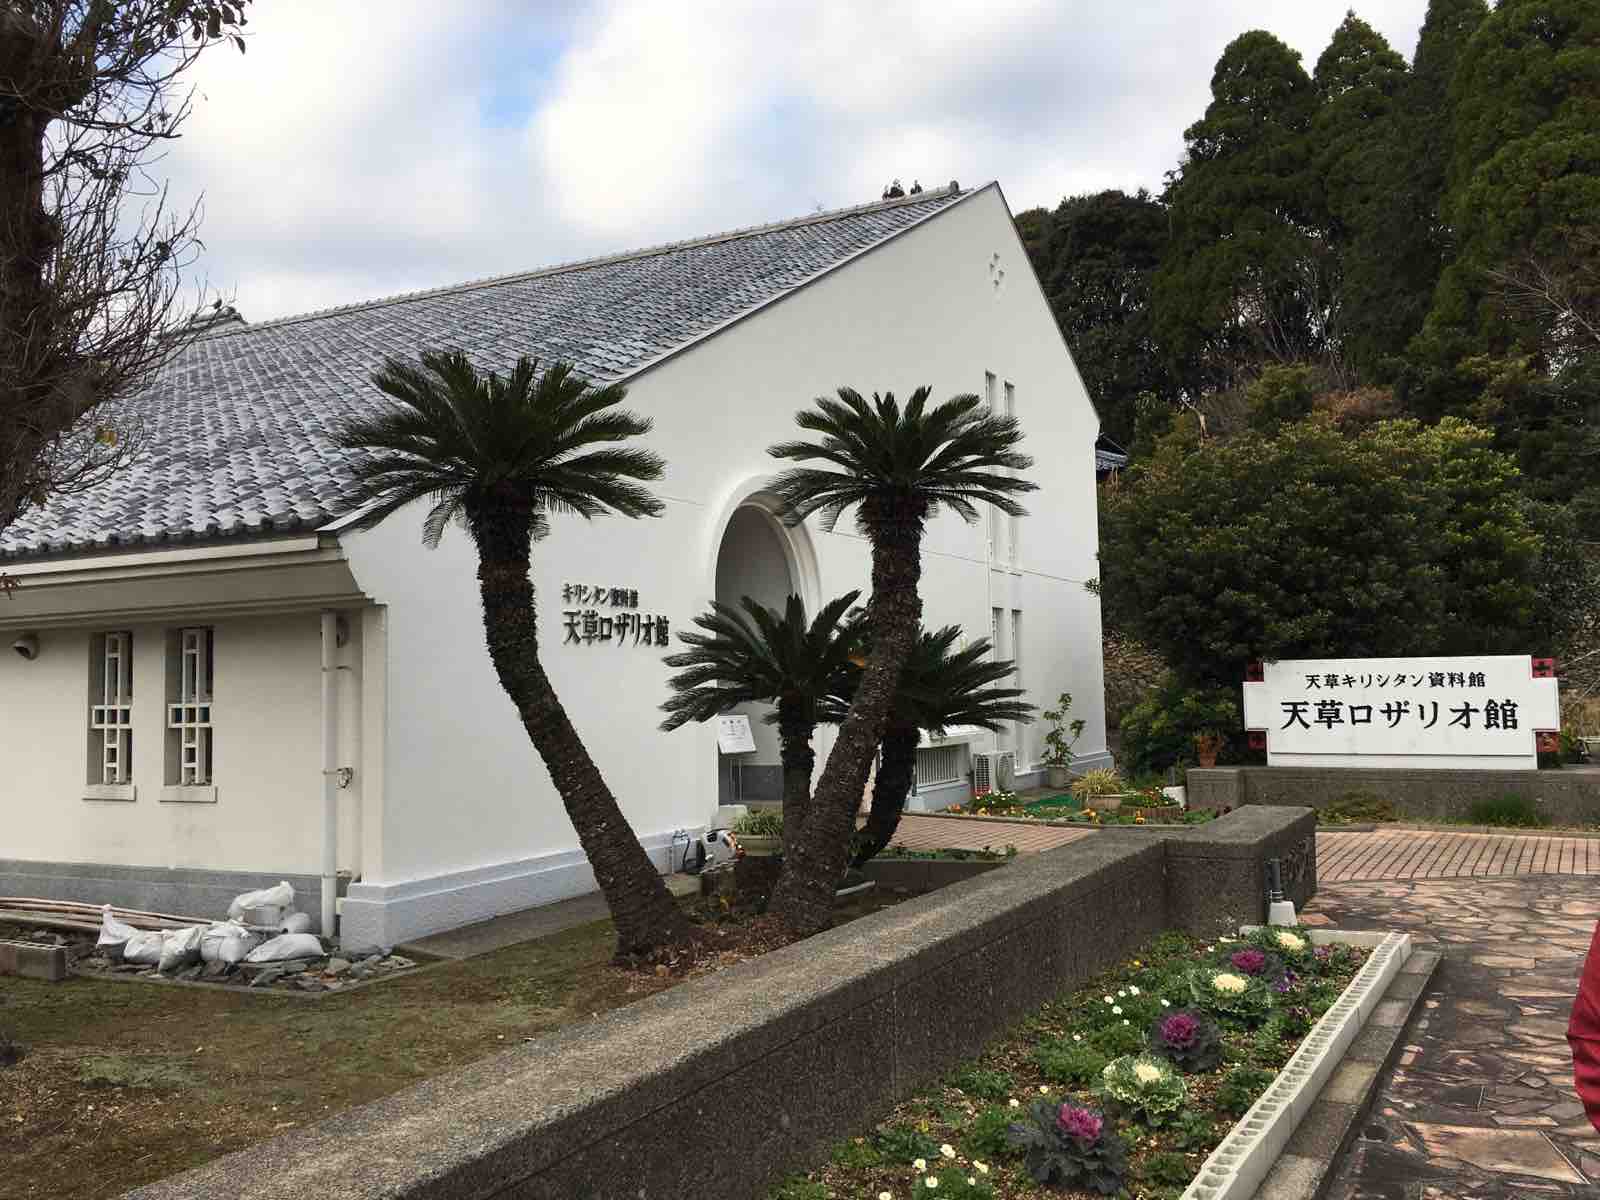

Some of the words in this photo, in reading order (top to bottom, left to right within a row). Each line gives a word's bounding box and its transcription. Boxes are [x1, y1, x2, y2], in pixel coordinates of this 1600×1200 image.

[562, 609, 669, 647] 天草ロザリオ館
[1305, 671, 1486, 690] 天草キリシタン資料館
[1280, 699, 1519, 730] 天草ロザリオ館
